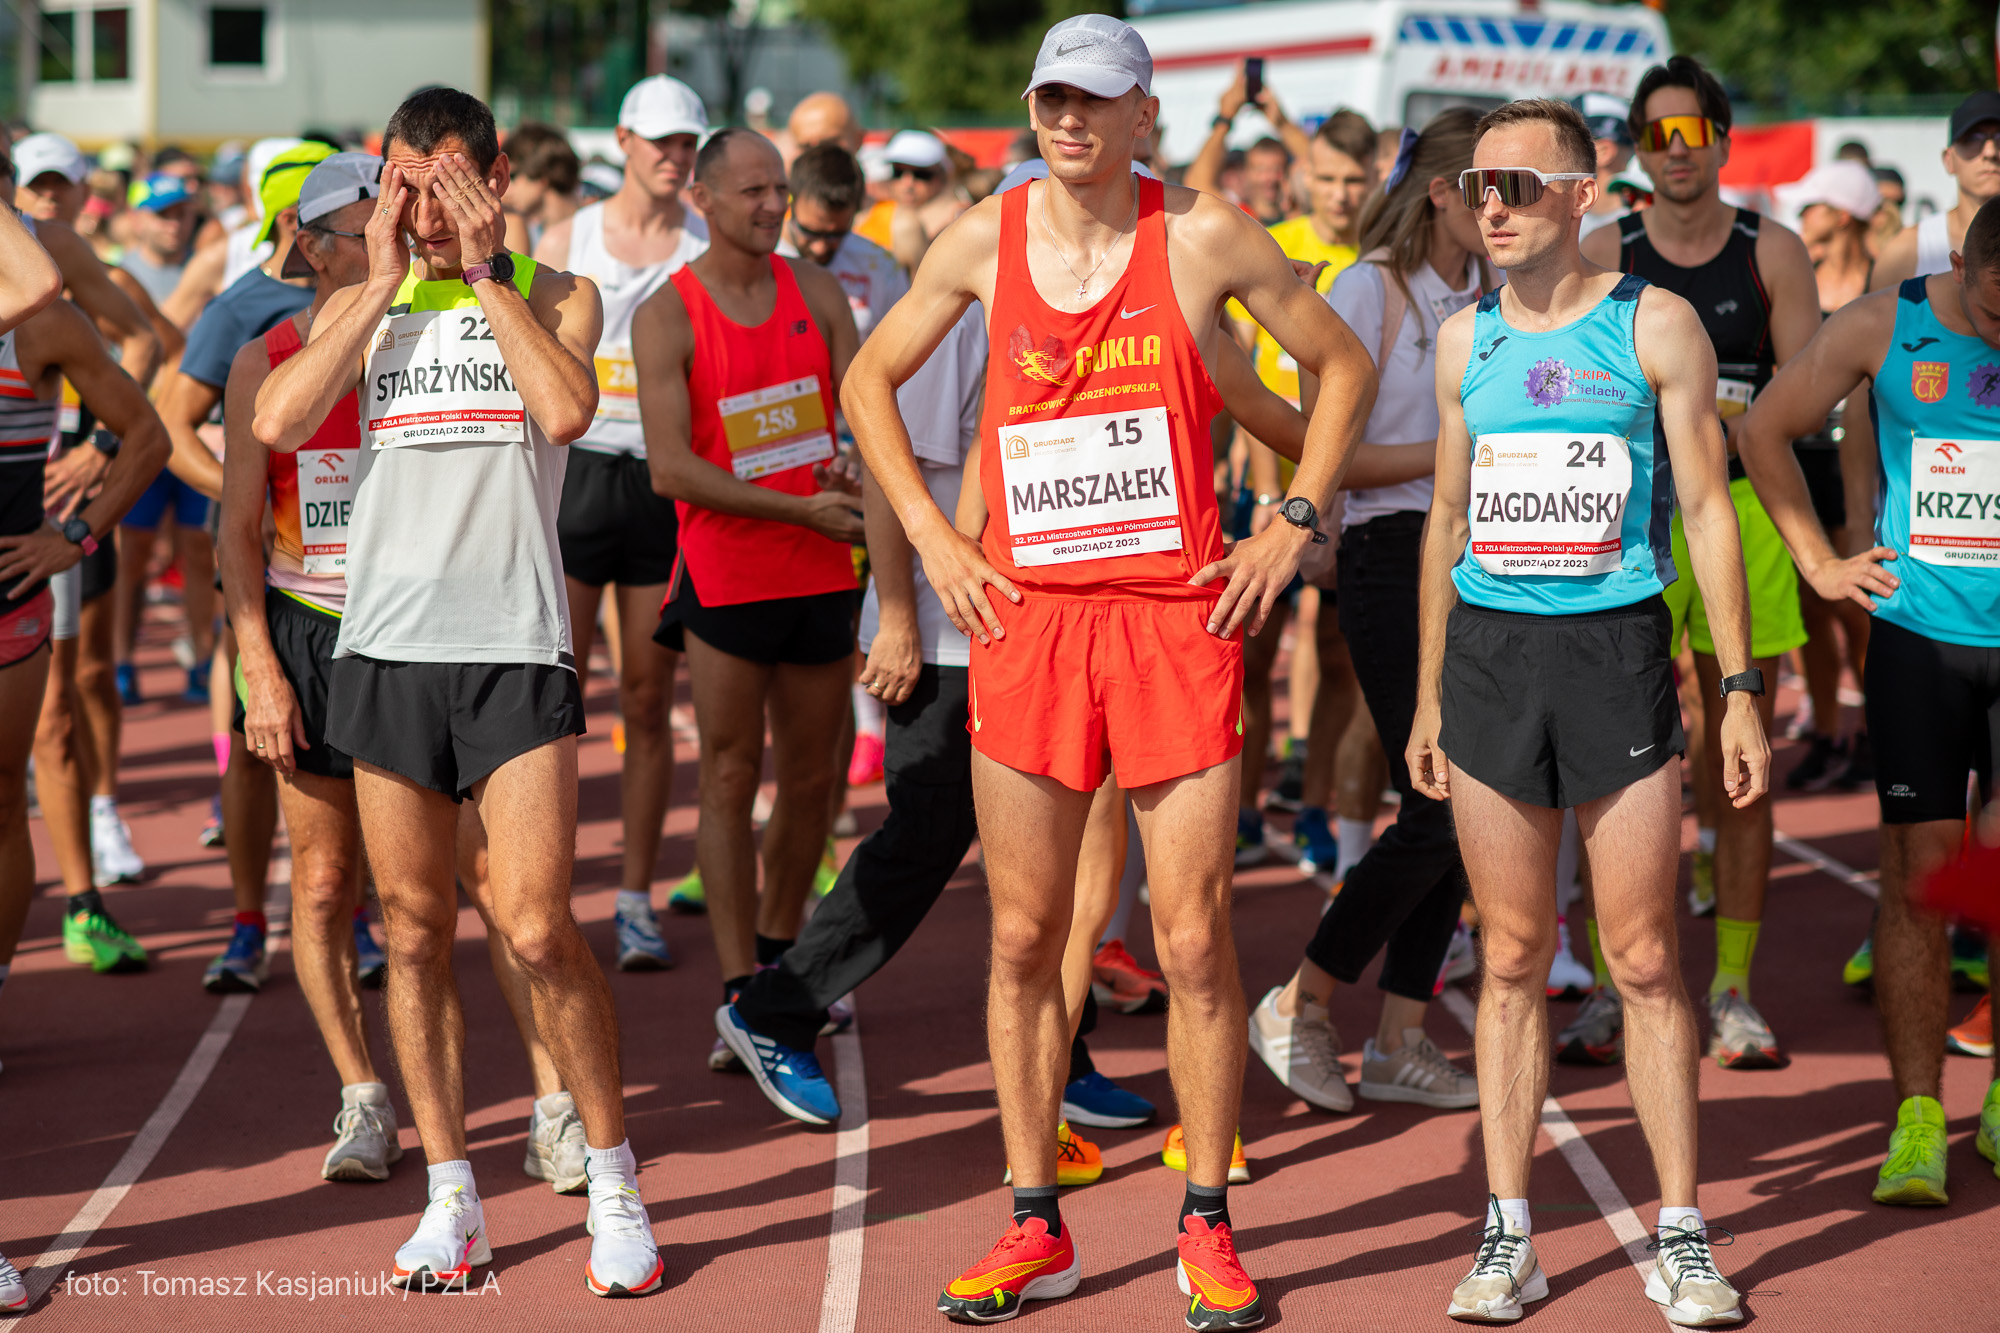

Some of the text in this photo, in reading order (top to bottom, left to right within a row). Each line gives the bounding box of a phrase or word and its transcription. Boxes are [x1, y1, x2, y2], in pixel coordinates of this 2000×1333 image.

[1076, 335, 1161, 378] GUKLA
[1574, 369, 1611, 382] EKIPA
[1572, 384, 1626, 401] Bielachy
[1914, 378, 1941, 399] CK
[372, 421, 382, 429] 32.
[383, 419, 398, 427] PZLA
[399, 414, 440, 425] Mistrzostwa
[441, 412, 462, 420] Polski
[471, 412, 520, 421] Półmaratonie
[754, 404, 798, 438] 258
[403, 426, 485, 438] GRUDZIĄDZ 2023
[1104, 417, 1143, 448] 15
[1033, 437, 1075, 448] GRUDZIĄDZ
[1497, 452, 1538, 460] GRUDZIĄDZ
[1566, 441, 1607, 468] 24
[1930, 466, 1966, 475] ORLEN
[315, 475, 349, 485] ORLEN
[1011, 466, 1171, 515] MARSZAŁEK
[1476, 486, 1622, 523] ZAGDAŃSKI
[305, 500, 351, 528] DZIE
[1015, 536, 1026, 545] 32.
[1027, 534, 1046, 543] PZLA
[1046, 529, 1092, 541] Mistrzostwa
[1093, 525, 1115, 534] Polski
[1124, 518, 1176, 531] Półmaratonie
[1053, 537, 1141, 555] GRUDZIĄDZ 2023
[1475, 544, 1485, 552] 32.
[1500, 544, 1542, 552] Mistrzostwa
[1543, 544, 1565, 552] Polski
[1574, 541, 1620, 553] Półmaratonie
[1502, 559, 1589, 569] GRUDZIĄDZ 2023
[1944, 552, 1999, 562] GRUDZIĄDZ
